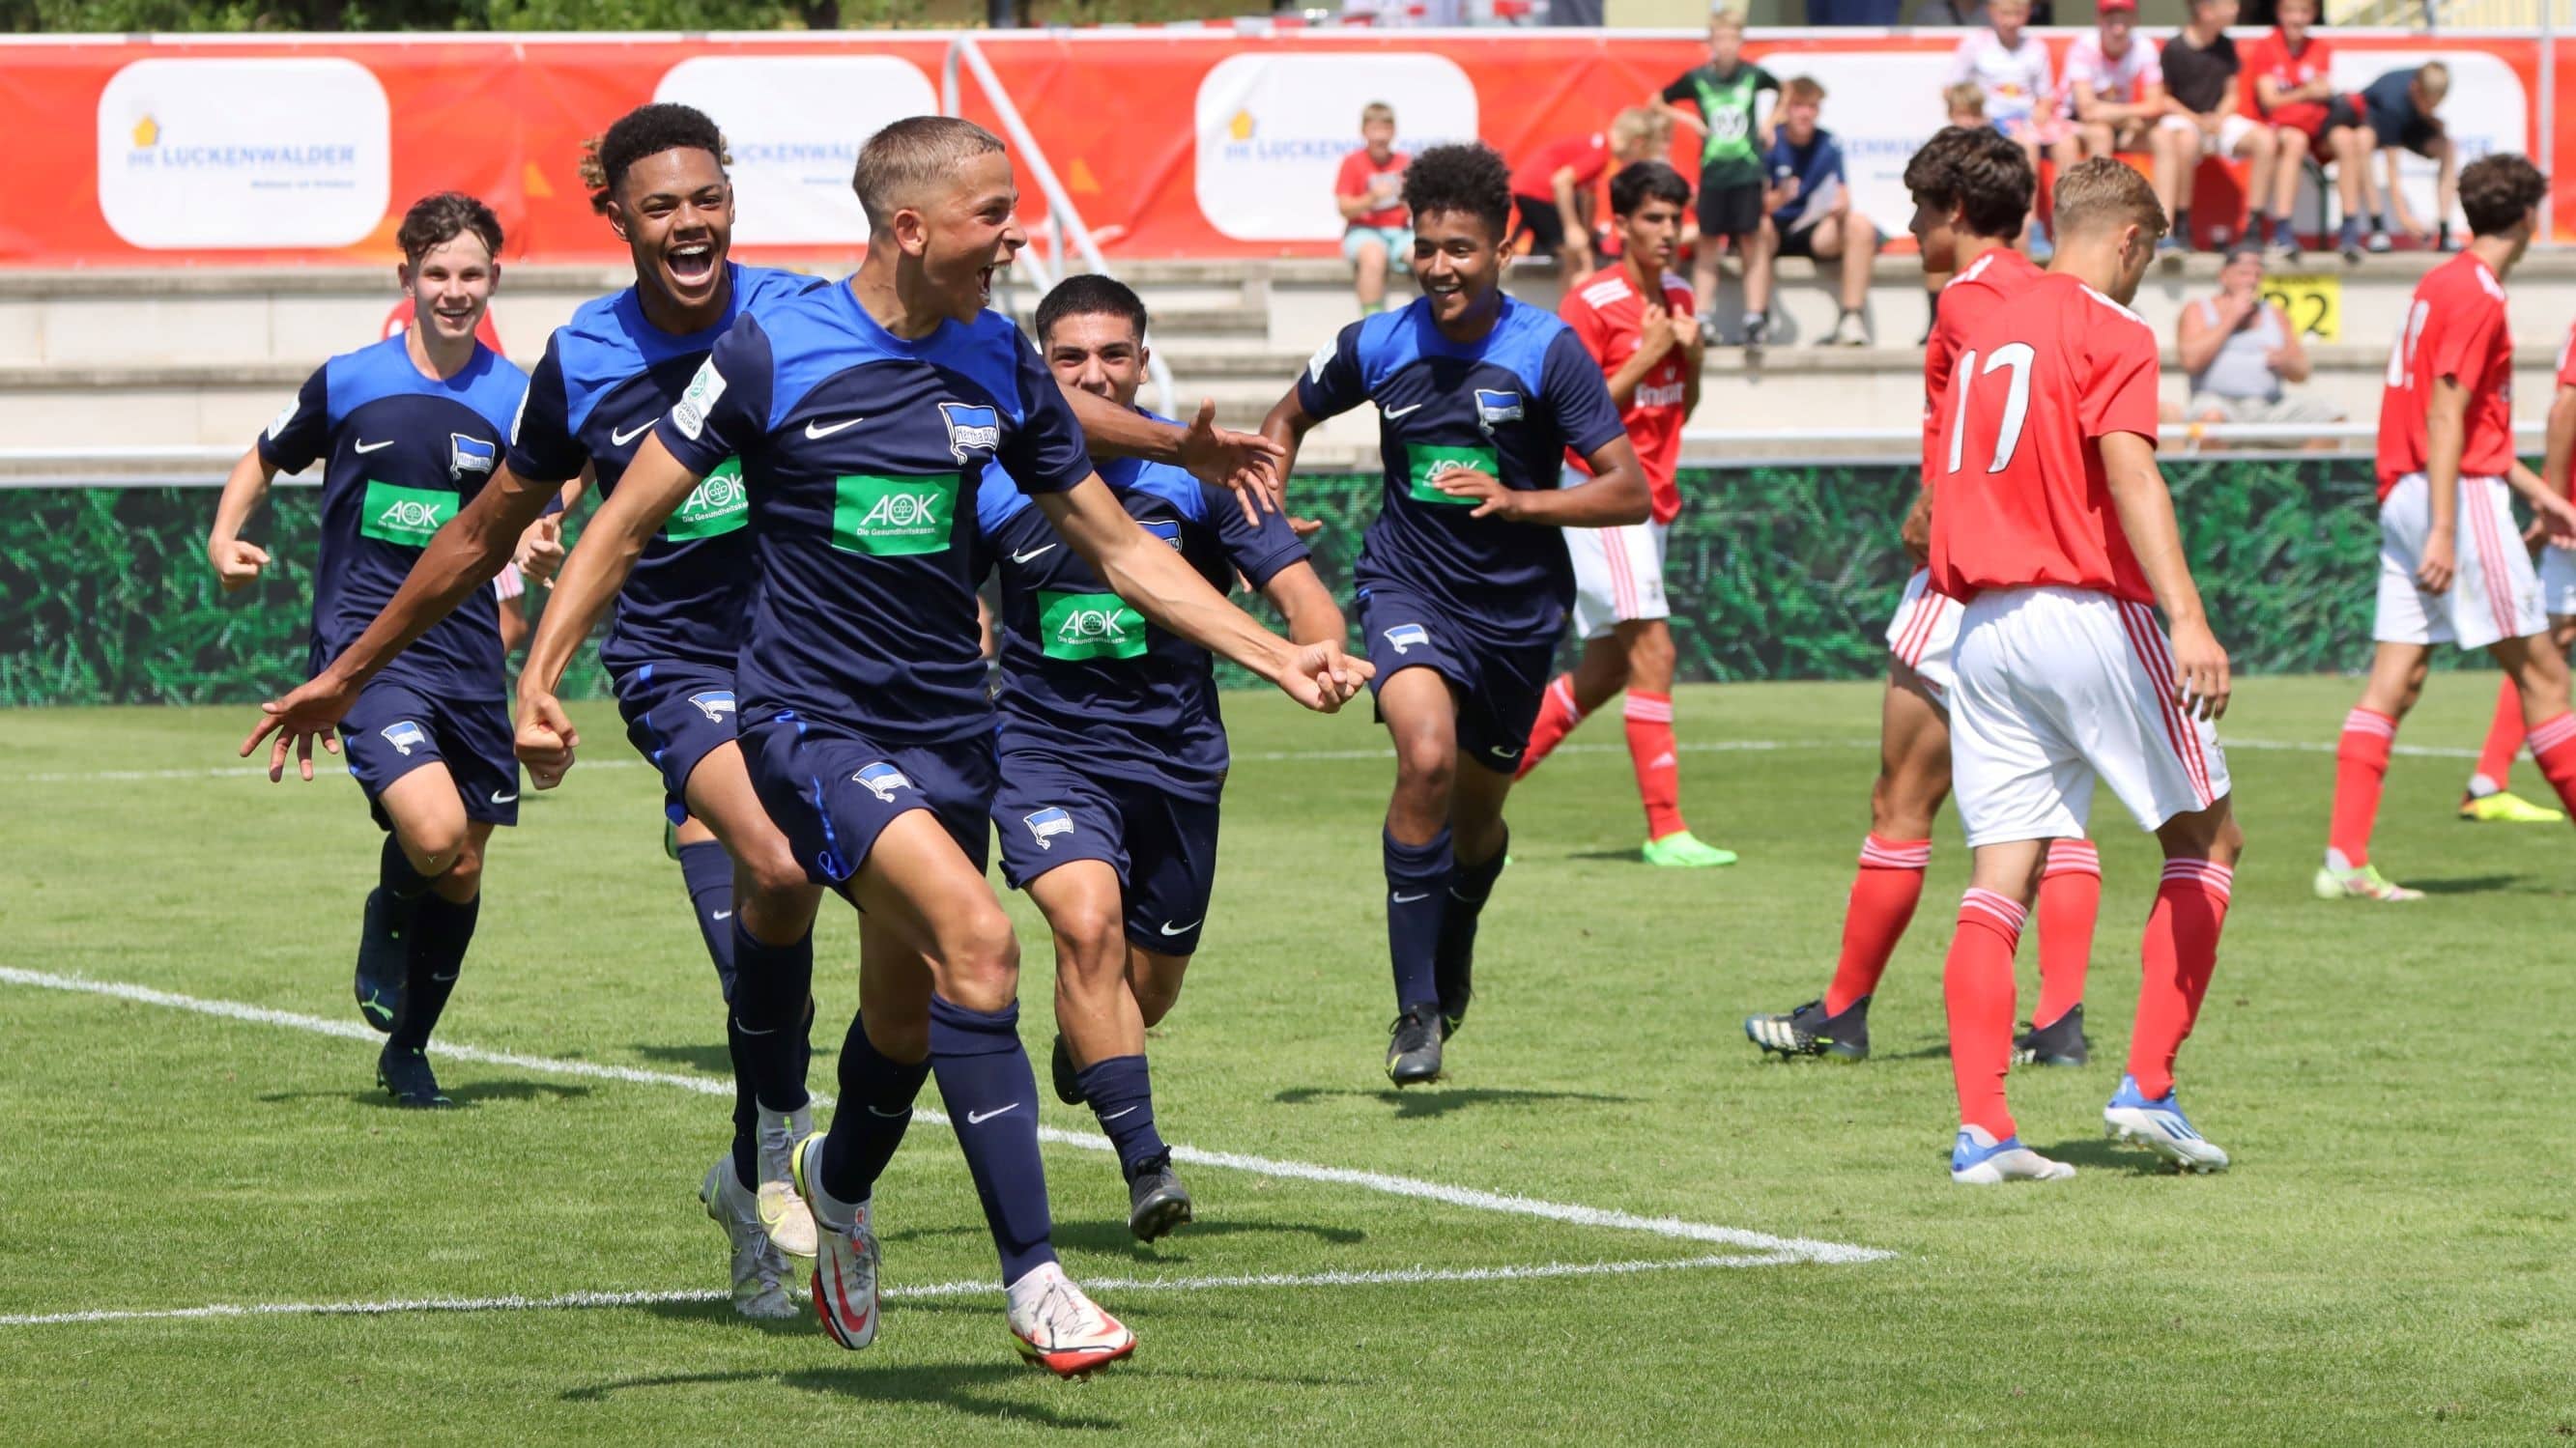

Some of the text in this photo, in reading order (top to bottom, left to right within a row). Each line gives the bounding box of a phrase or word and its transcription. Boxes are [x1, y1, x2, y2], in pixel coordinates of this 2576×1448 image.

[162, 146, 355, 166] LUCKENWALDER
[1948, 341, 2036, 474] 17
[682, 472, 747, 515] AOK
[380, 499, 442, 528] AOK
[859, 493, 940, 526] AOK
[1058, 609, 1126, 637] AOK
